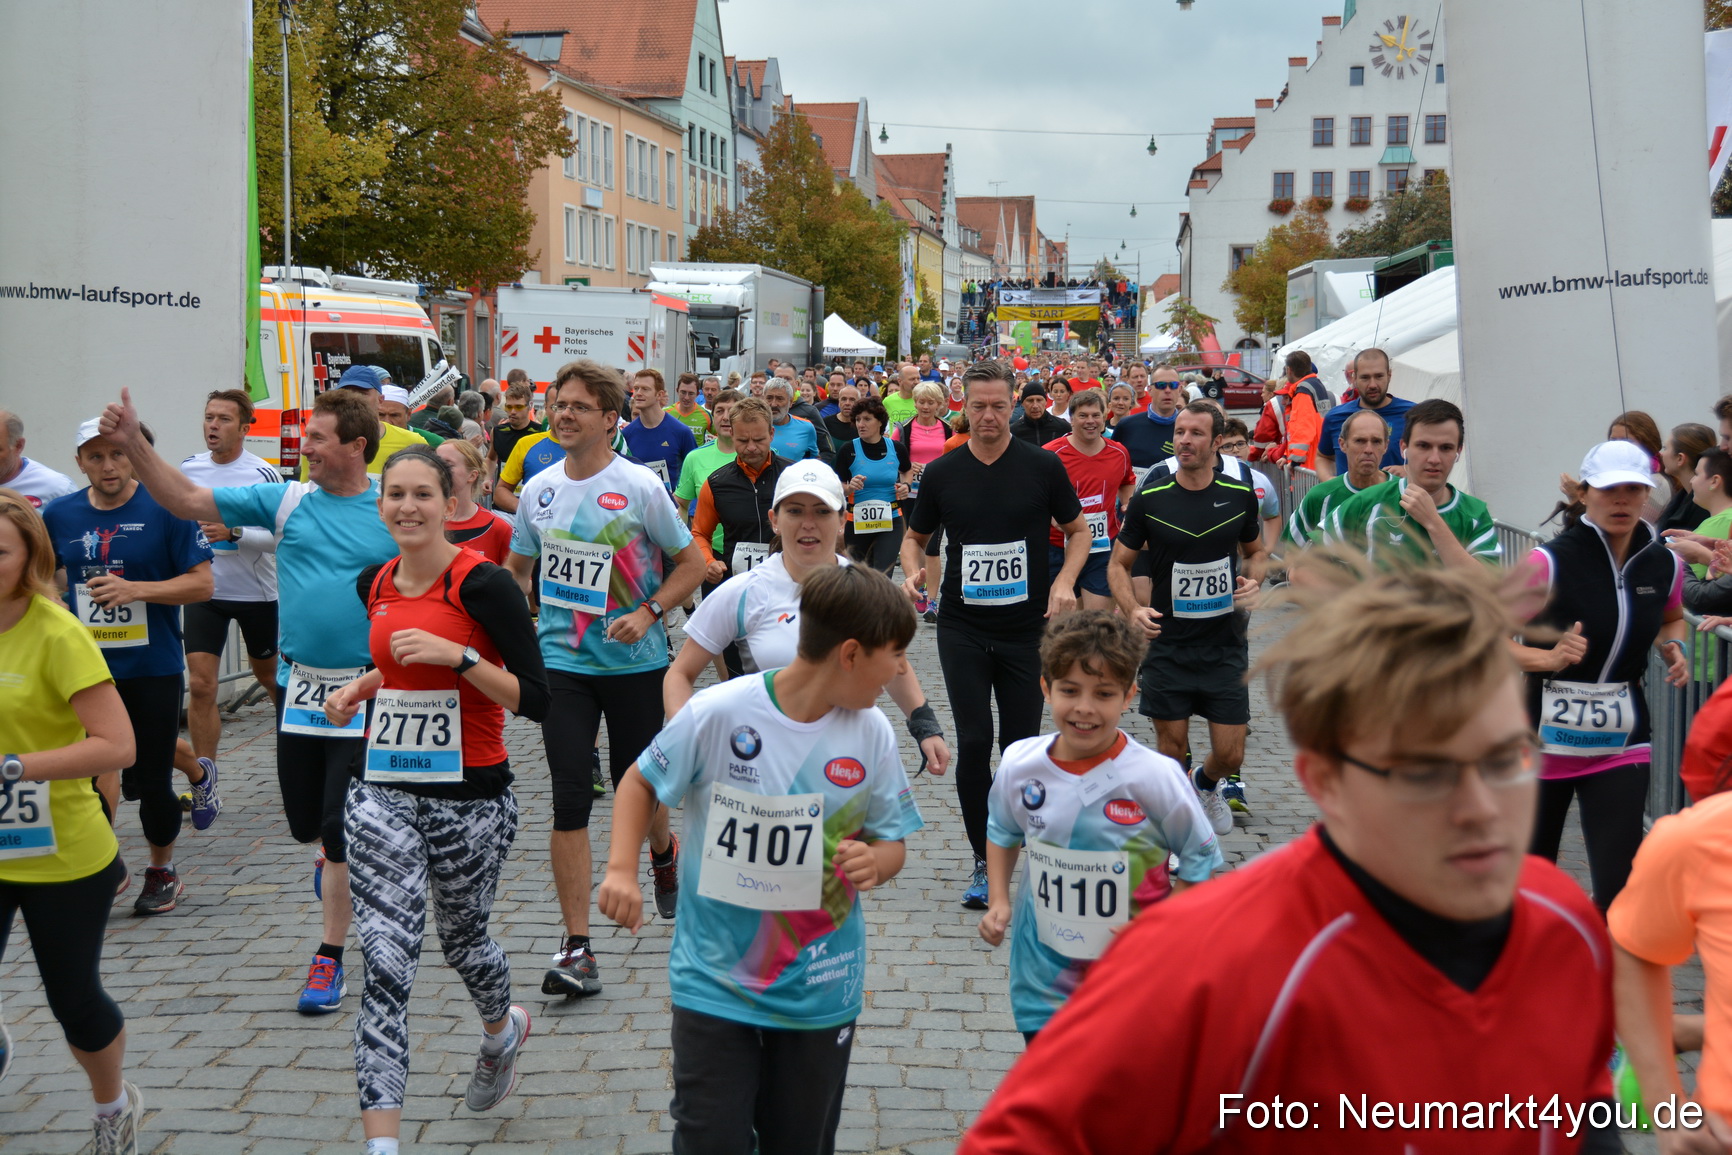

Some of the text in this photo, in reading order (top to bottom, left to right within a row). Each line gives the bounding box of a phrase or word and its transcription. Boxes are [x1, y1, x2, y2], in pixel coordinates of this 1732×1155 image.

[1499, 267, 1709, 300] www.bmw-laufsport.de
[0, 282, 200, 308] www.bmw-laufsport.de
[1029, 309, 1066, 319] START
[565, 327, 614, 338] Bayerisches
[565, 337, 588, 346] Rotes
[564, 347, 588, 356] Kreuz
[826, 346, 860, 355] Laufsport
[601, 496, 625, 507] Hervis
[861, 507, 884, 520] 307
[543, 541, 600, 559] PARTL Neumarkt
[964, 548, 1016, 558] PARTL Neumarkt
[547, 553, 605, 587] 2417
[968, 557, 1022, 583] 2766
[1173, 566, 1224, 575] PARTL Neumarkt
[976, 585, 1016, 598] Christian
[1178, 572, 1228, 598] 2788
[555, 586, 590, 604] Andreas
[89, 600, 132, 624] 295
[1186, 600, 1223, 611] Christian
[92, 630, 128, 639] Werner
[293, 668, 354, 682] PARTL Neumarkt
[1544, 686, 1576, 695] PARTL
[376, 697, 442, 708] PARTL Neumarkt
[1552, 698, 1622, 729] 2751
[376, 712, 451, 746] 2773
[1554, 731, 1613, 746] Stephanie
[390, 755, 431, 769] Bianka
[729, 762, 760, 777] PARTL
[831, 762, 860, 780] Hervis
[714, 794, 804, 819] PARTL Neumarkt
[717, 817, 813, 867] 4107
[1029, 851, 1107, 873] PARTL Neumarkt
[1038, 870, 1117, 918] 4110
[806, 964, 849, 985] Stadtlauf
